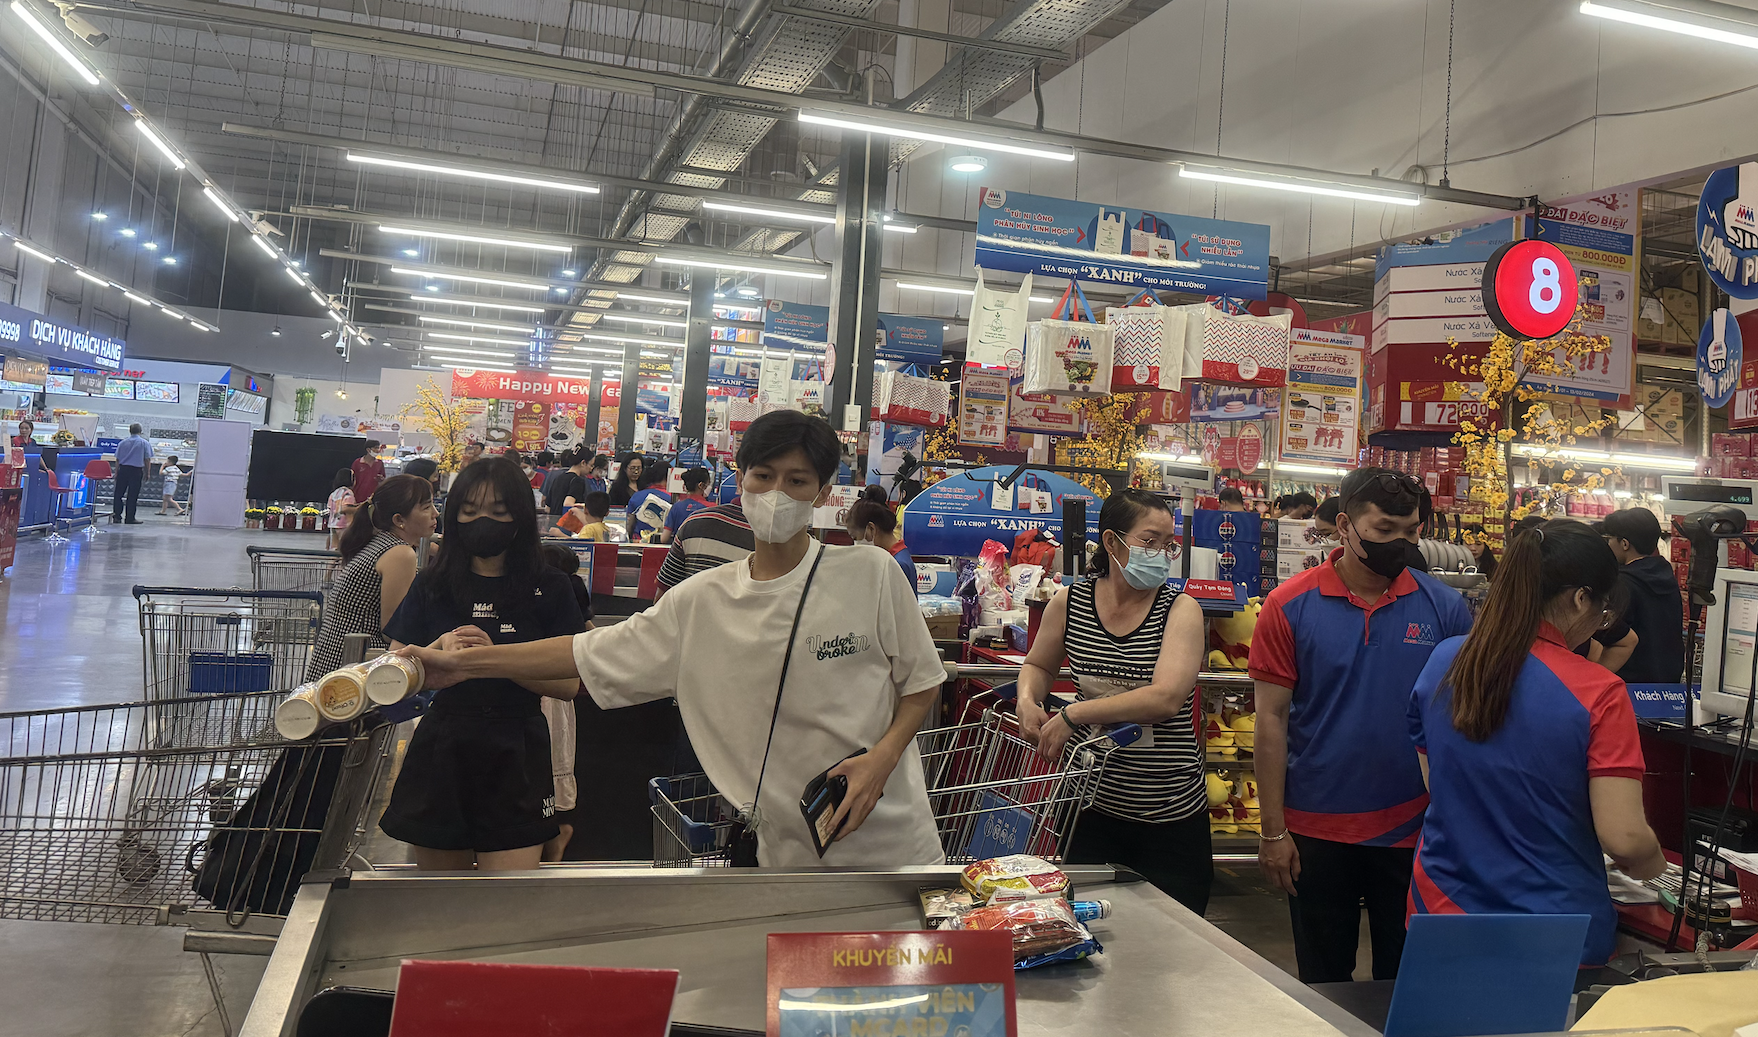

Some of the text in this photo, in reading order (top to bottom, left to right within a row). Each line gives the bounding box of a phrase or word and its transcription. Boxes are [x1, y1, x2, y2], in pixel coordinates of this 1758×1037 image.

[1023, 212, 1031, 220] NI
[1033, 213, 1054, 223] LÔNG
[993, 219, 1014, 229] PHÂN
[1032, 225, 1050, 234] SINH
[1582, 251, 1626, 265] 800.000Đ
[1041, 264, 1207, 290] LỰA CHỌN “XANH” CHO MÔI TRƯỜNG!
[1446, 268, 1468, 277] Nước
[1529, 257, 1561, 314] 8
[1445, 296, 1467, 304] Nước
[1443, 323, 1466, 331] Nước
[32, 319, 56, 346] DỊCH
[58, 327, 71, 352] VỤ
[72, 330, 100, 355] KHÁCH
[100, 338, 122, 360] HÀNG
[499, 377, 622, 398] Happy New Yea
[991, 518, 1045, 532] “XANH”
[1634, 690, 1661, 701] Khách
[1662, 690, 1685, 704] Hàng
[918, 943, 952, 966] MÃI
